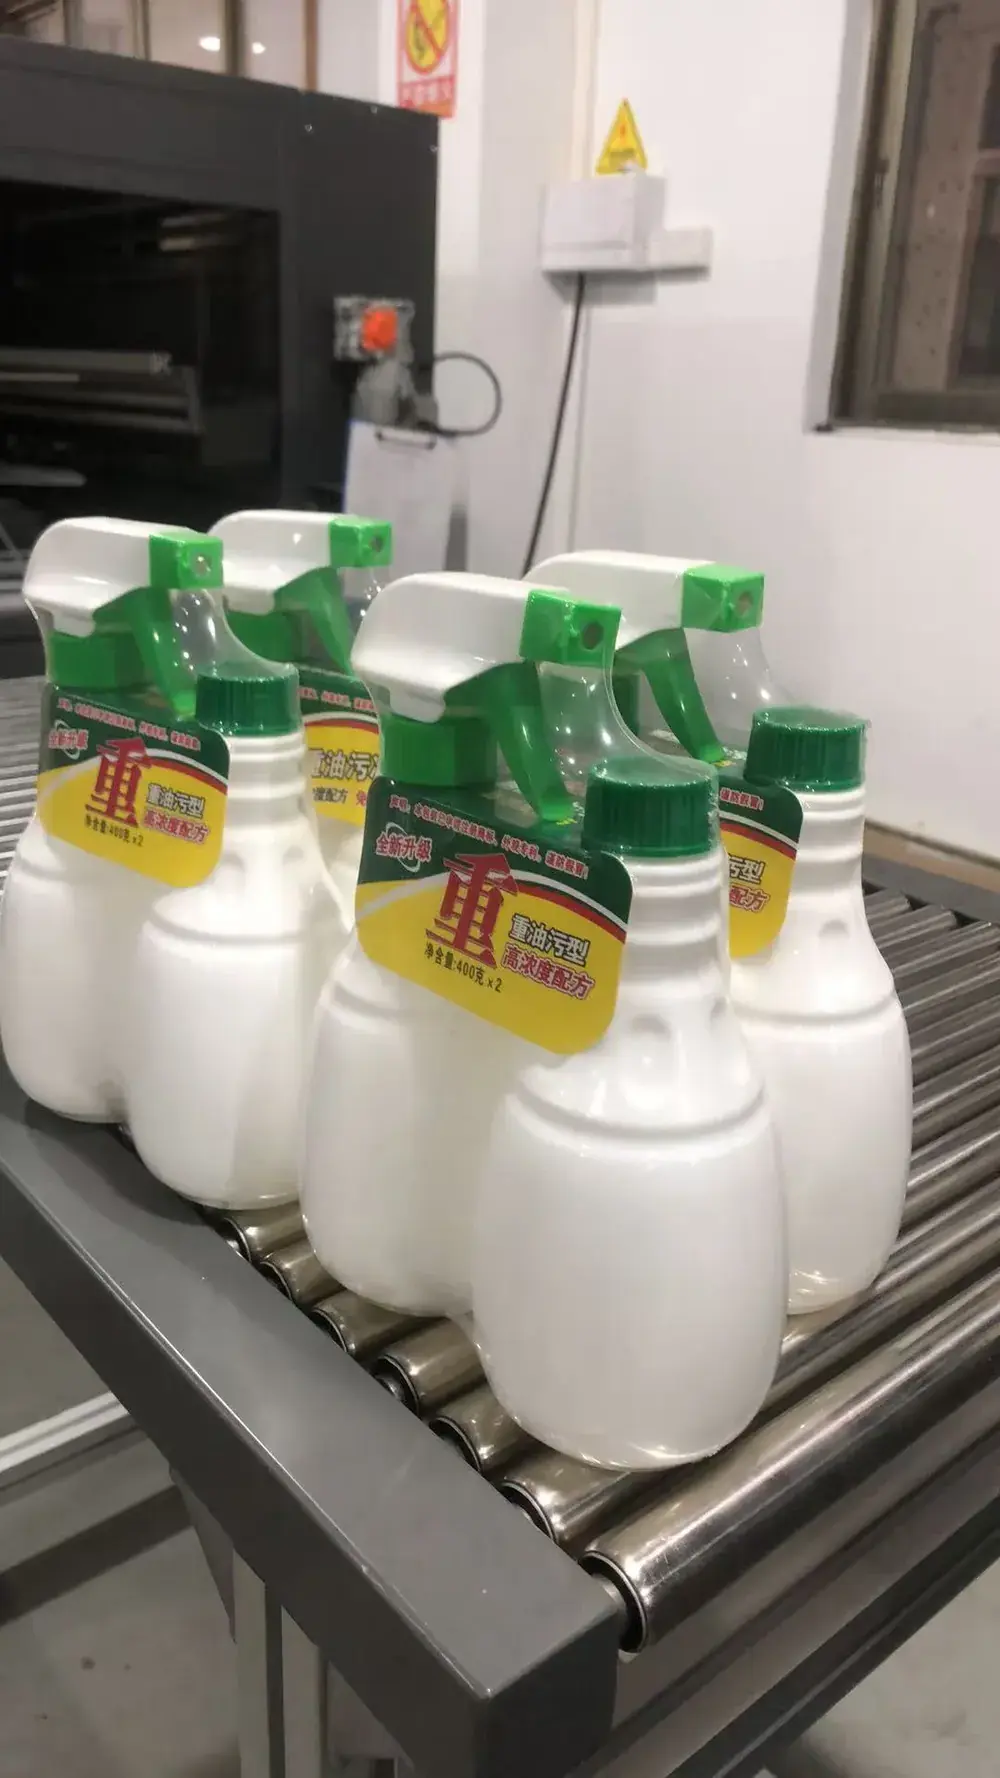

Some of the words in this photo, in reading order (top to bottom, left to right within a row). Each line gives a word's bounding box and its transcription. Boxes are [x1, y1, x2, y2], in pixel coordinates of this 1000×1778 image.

[85, 736, 152, 828] 重
[376, 831, 432, 863] 全新升级
[425, 852, 519, 969] 重
[508, 912, 591, 968] 重油污型
[500, 943, 596, 1001] 高浓度配方
